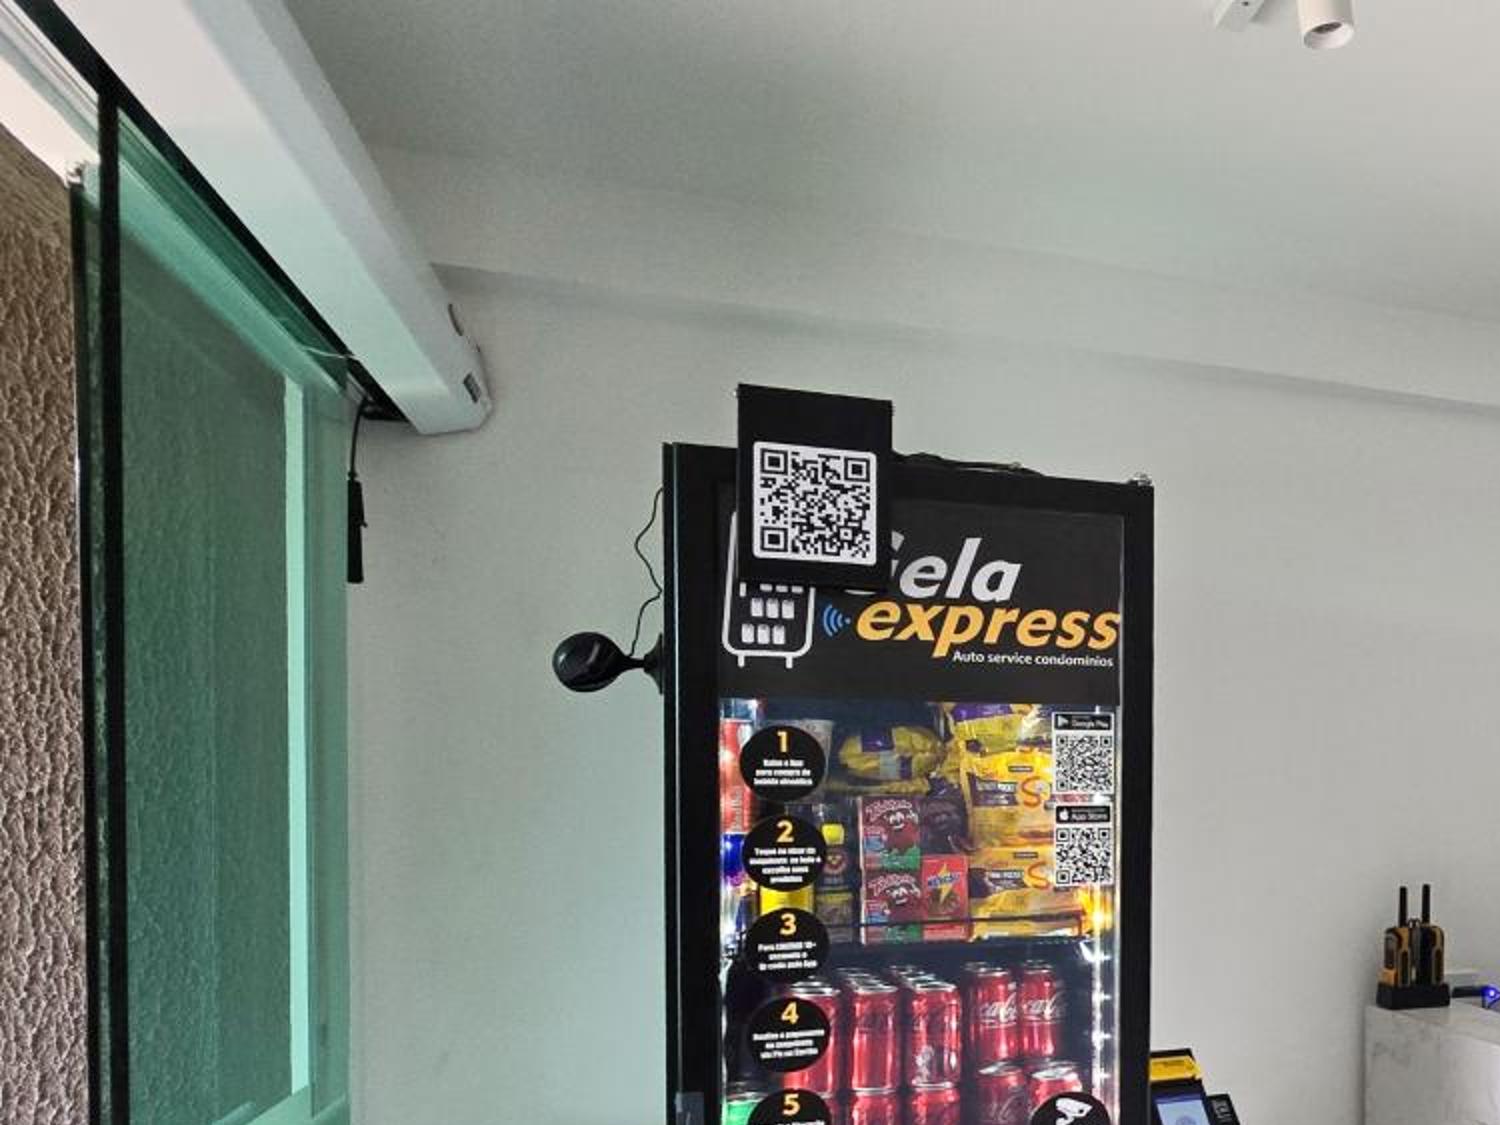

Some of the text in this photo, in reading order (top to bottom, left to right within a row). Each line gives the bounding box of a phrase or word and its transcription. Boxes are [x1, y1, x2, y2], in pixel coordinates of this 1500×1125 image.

[892, 531, 1022, 602] ela
[856, 599, 1121, 659] express
[952, 651, 985, 663] Auto
[986, 652, 1033, 665] service
[777, 731, 788, 753] 1
[776, 820, 795, 843] 2
[780, 912, 797, 936] 3
[781, 1001, 799, 1024] 4
[782, 1093, 801, 1116] 5
